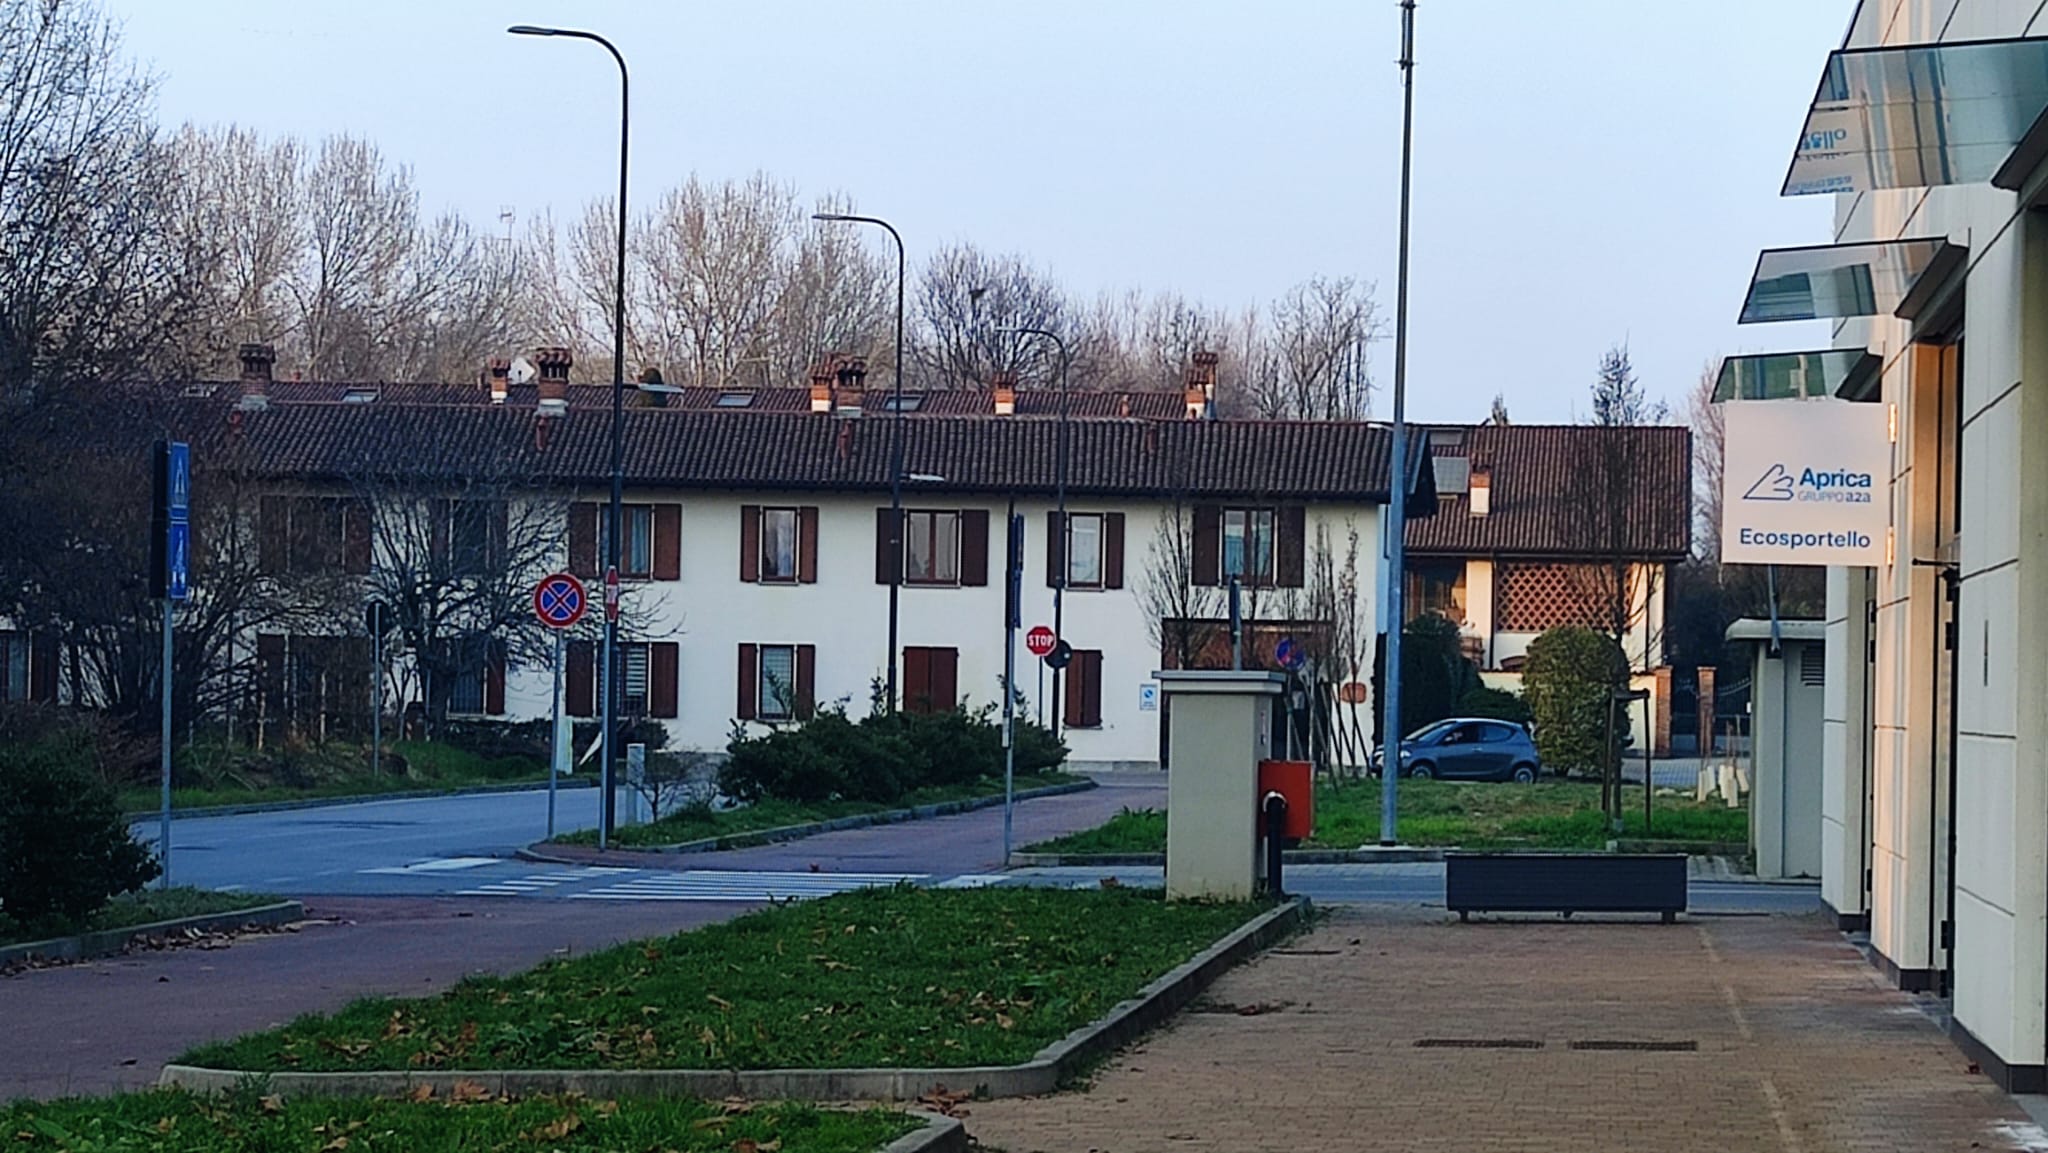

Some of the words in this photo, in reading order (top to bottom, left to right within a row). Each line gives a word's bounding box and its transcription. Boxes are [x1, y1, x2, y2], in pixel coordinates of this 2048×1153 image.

[1799, 467, 1871, 490] Aprica
[1797, 490, 1844, 502] GRUPPO
[1845, 491, 1871, 503] a2a
[1740, 528, 1871, 549] Ecosportello
[1028, 634, 1054, 647] STOP
